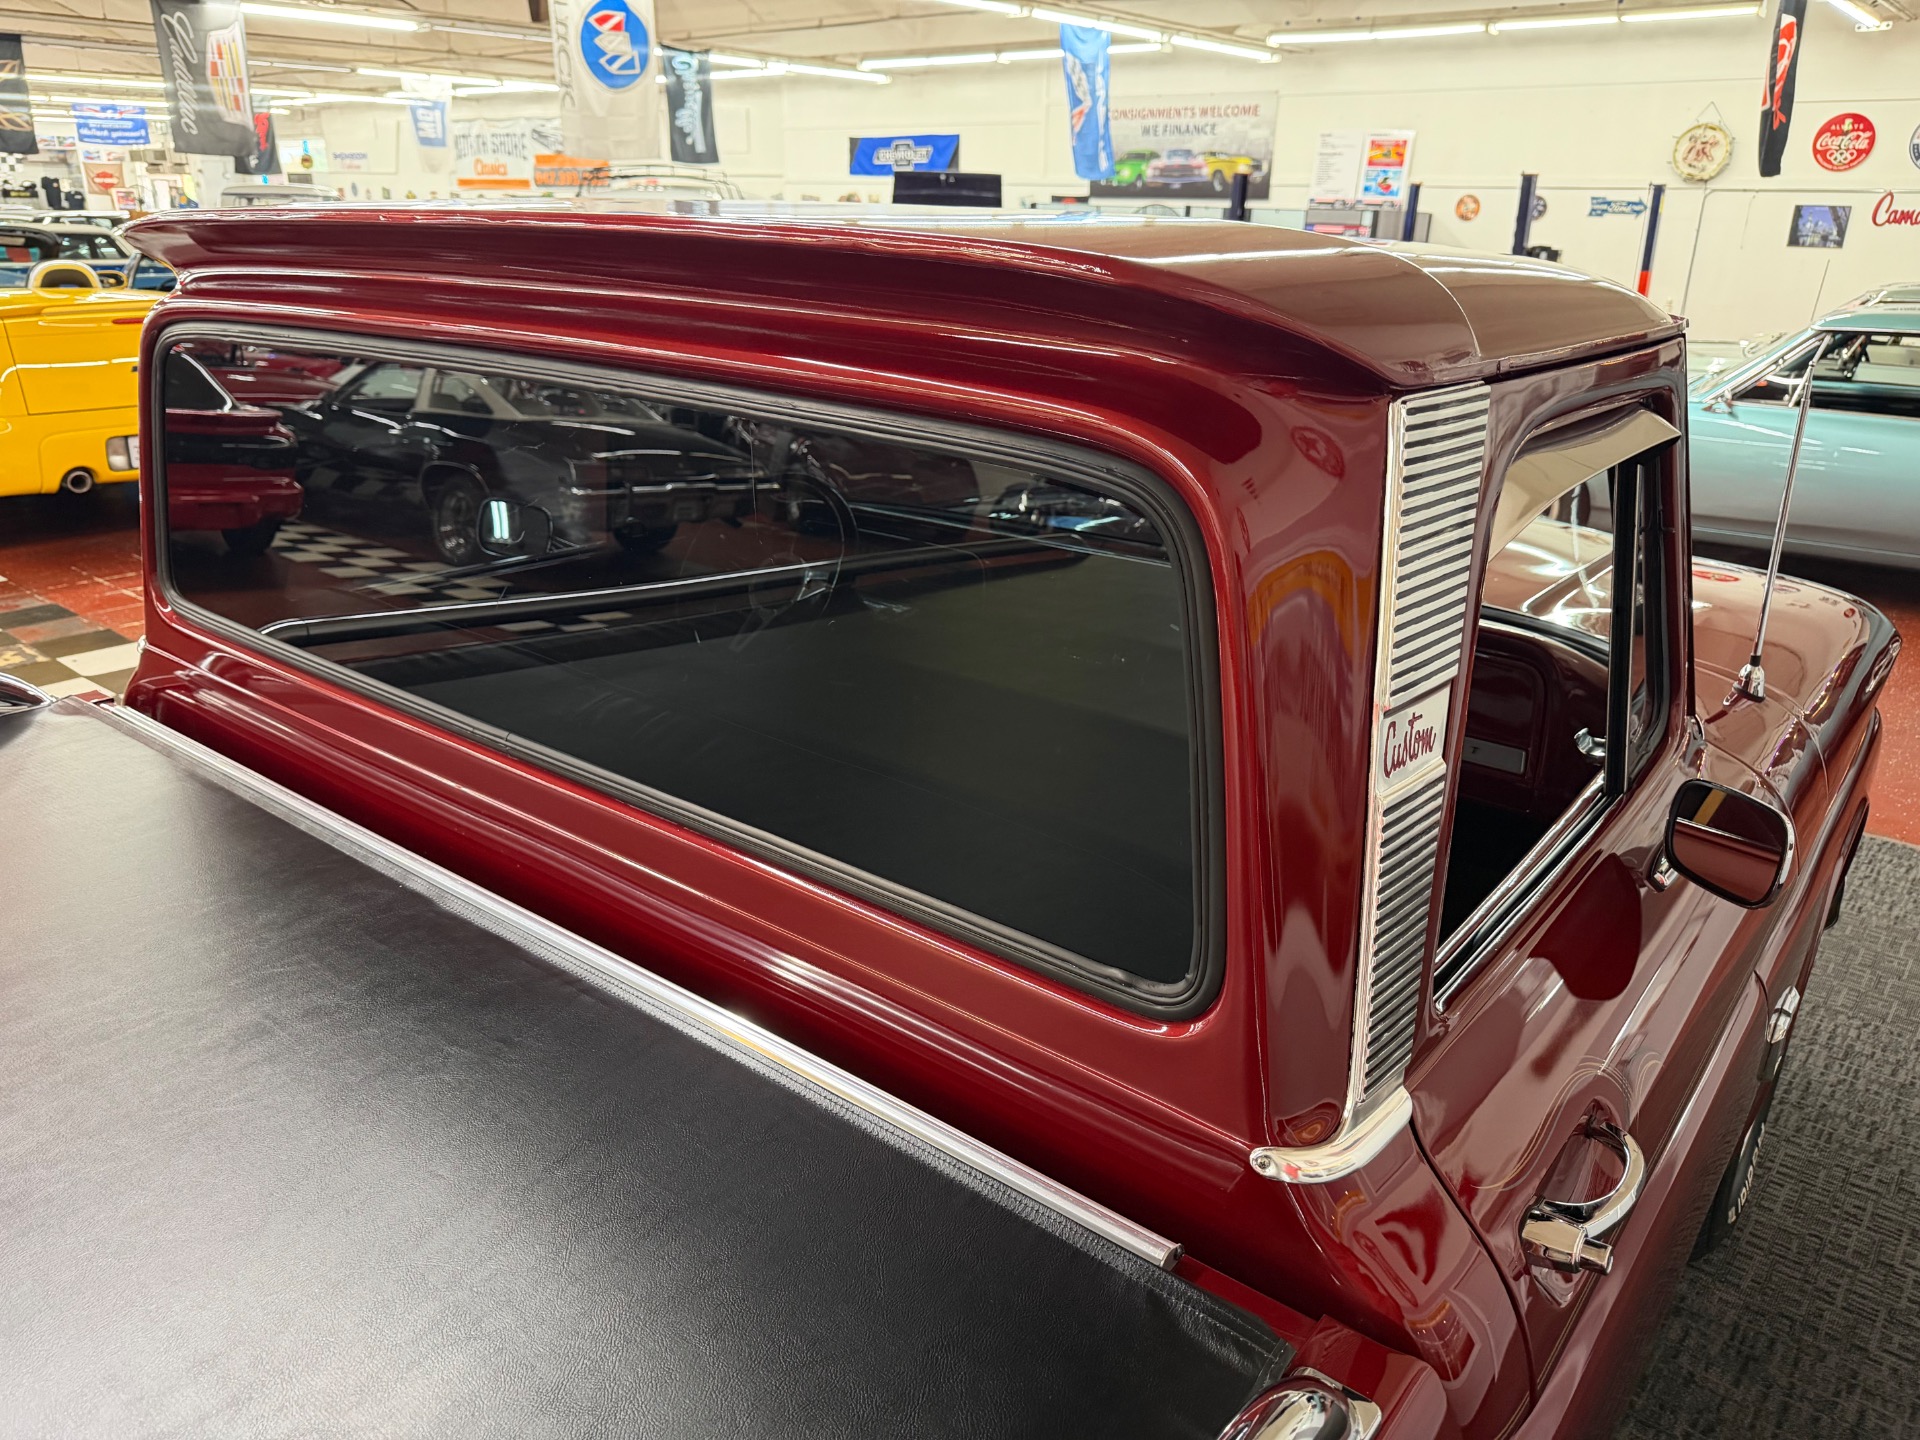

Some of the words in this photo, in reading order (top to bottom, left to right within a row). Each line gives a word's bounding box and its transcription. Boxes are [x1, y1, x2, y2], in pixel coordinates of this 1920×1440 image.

[160, 11, 199, 135] Cadillac
[1199, 103, 1261, 118] WELCOME
[1141, 124, 1160, 136] WE
[1162, 123, 1218, 136] FINANCE
[491, 132, 528, 161] SHORE
[878, 148, 928, 162] CHEVROLET
[1383, 712, 1437, 778] Custom
